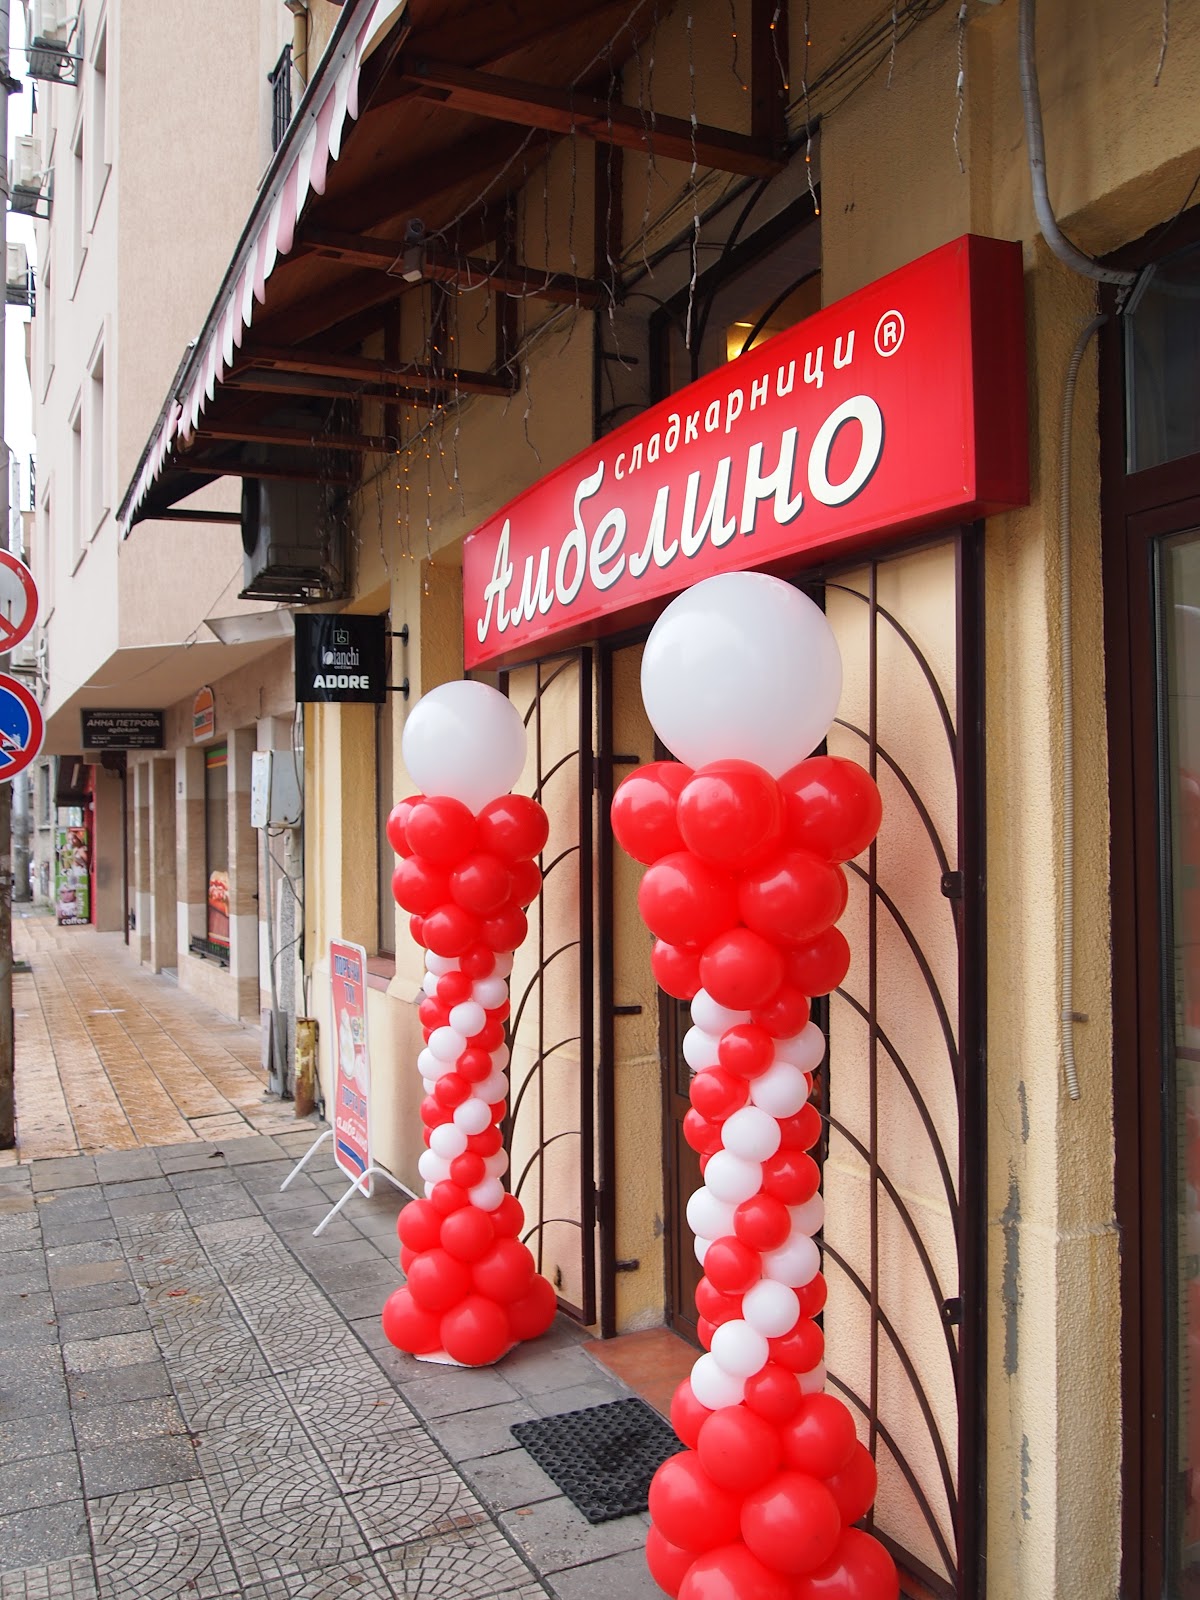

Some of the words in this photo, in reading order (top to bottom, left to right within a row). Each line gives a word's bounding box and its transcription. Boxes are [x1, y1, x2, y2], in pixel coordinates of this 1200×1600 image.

[614, 329, 856, 481] сладкарници
[476, 394, 886, 643] Амбелино
[313, 674, 370, 689] ADORE
[86, 718, 114, 727] АННА
[115, 718, 160, 727] ПЕТРОВА
[61, 917, 88, 925] coffee
